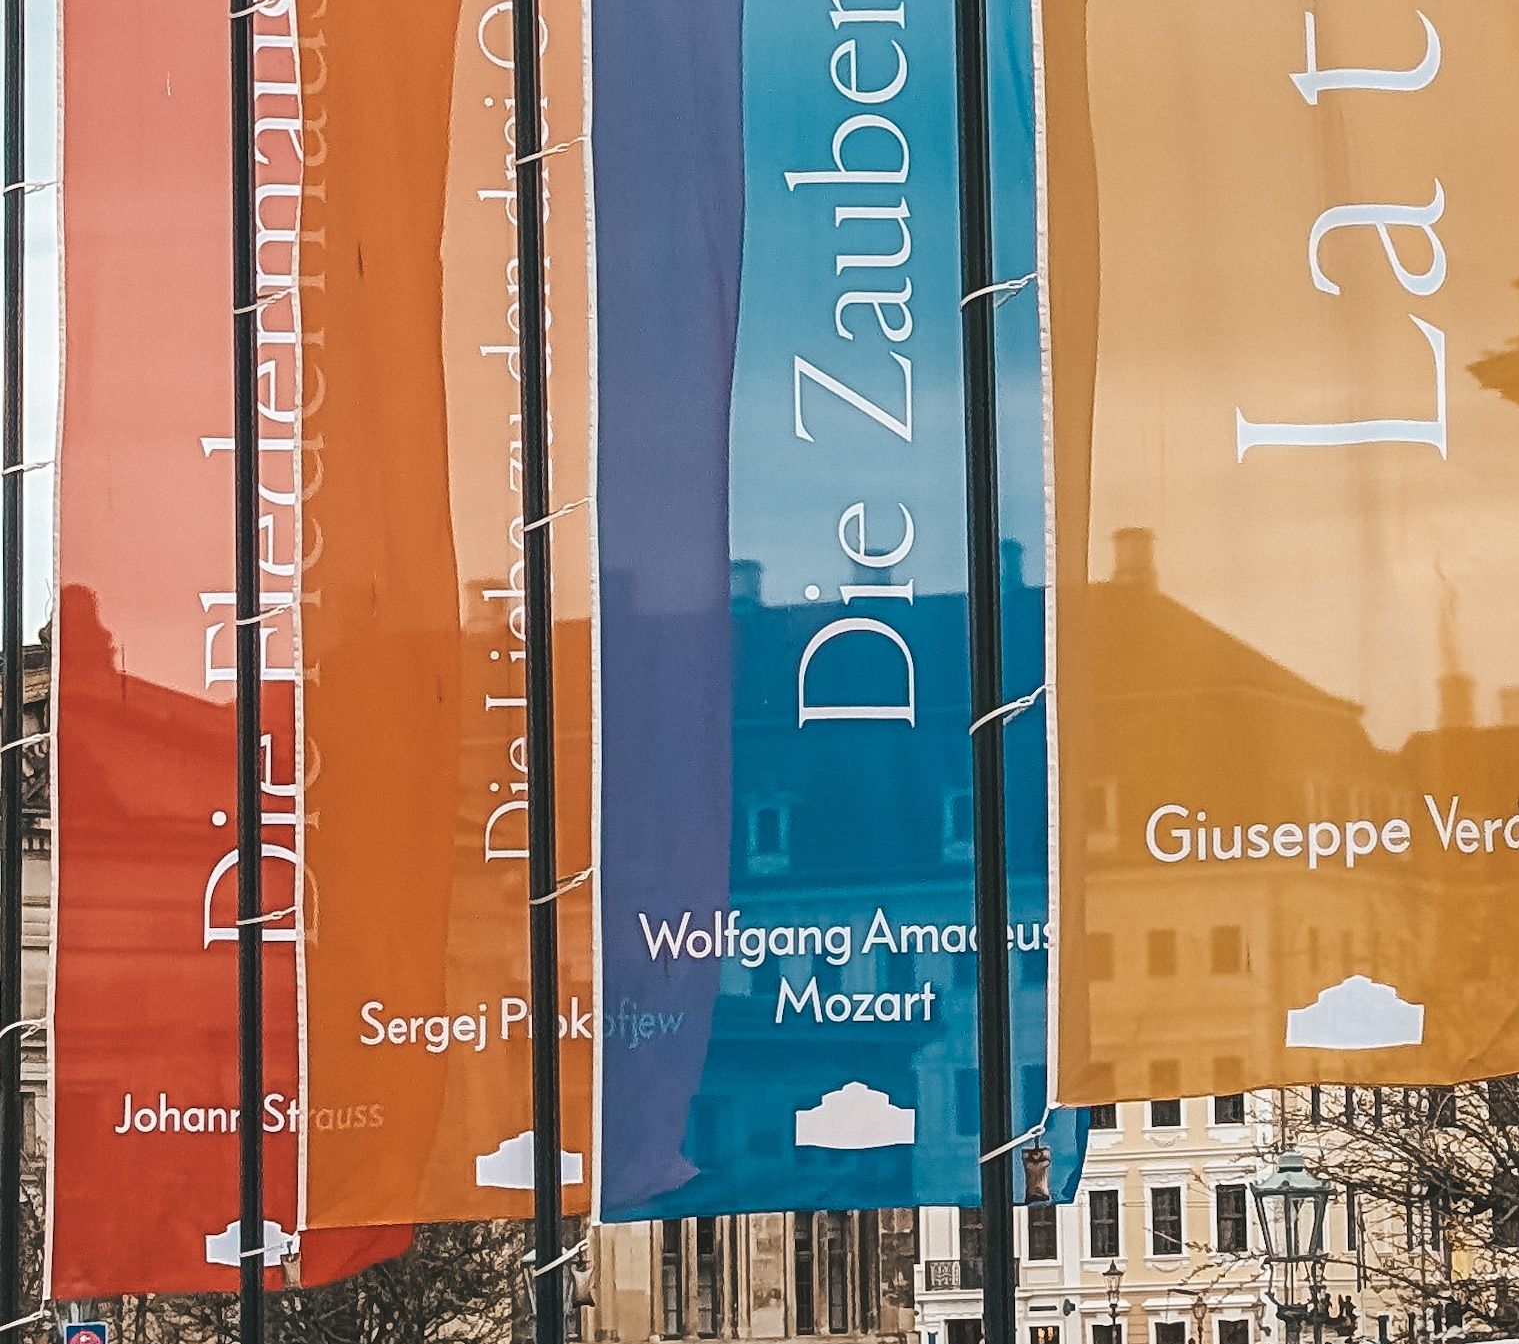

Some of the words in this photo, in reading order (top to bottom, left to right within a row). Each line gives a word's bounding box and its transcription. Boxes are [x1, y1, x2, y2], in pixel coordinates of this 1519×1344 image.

[1235, 177, 1447, 462] La
[797, 500, 917, 731] Die
[1145, 803, 1412, 870] Giuseppe
[638, 909, 851, 968] Wolfgang
[360, 1000, 488, 1054] Sergej
[775, 975, 936, 1025] Mozart
